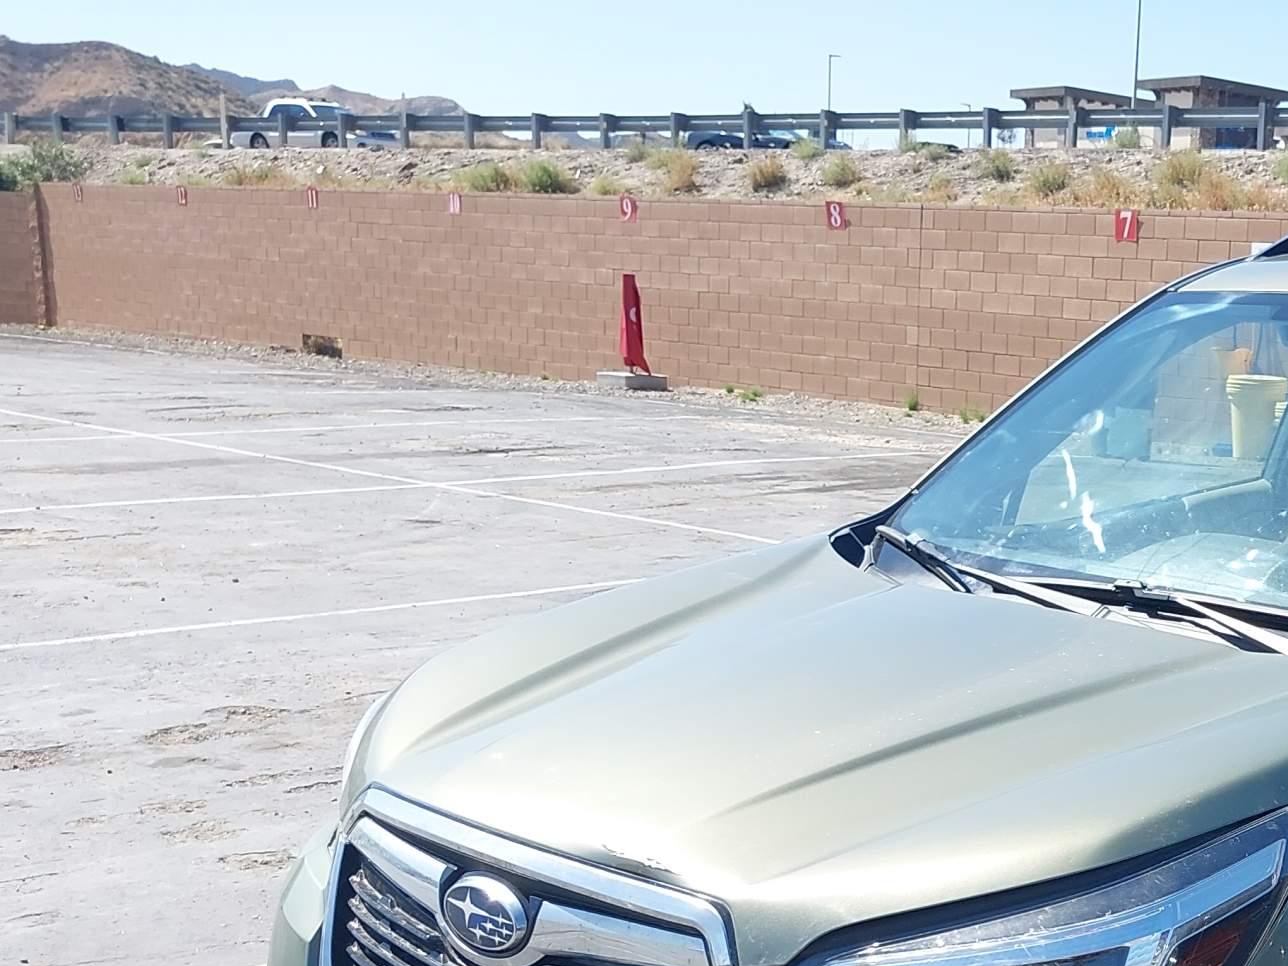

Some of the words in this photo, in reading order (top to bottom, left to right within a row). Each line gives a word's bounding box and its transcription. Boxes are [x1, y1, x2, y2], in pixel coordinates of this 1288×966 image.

[308, 189, 317, 208] 11
[449, 193, 460, 214] 10
[622, 199, 632, 221] 9
[830, 203, 841, 227] 8
[1120, 210, 1132, 239] 7
